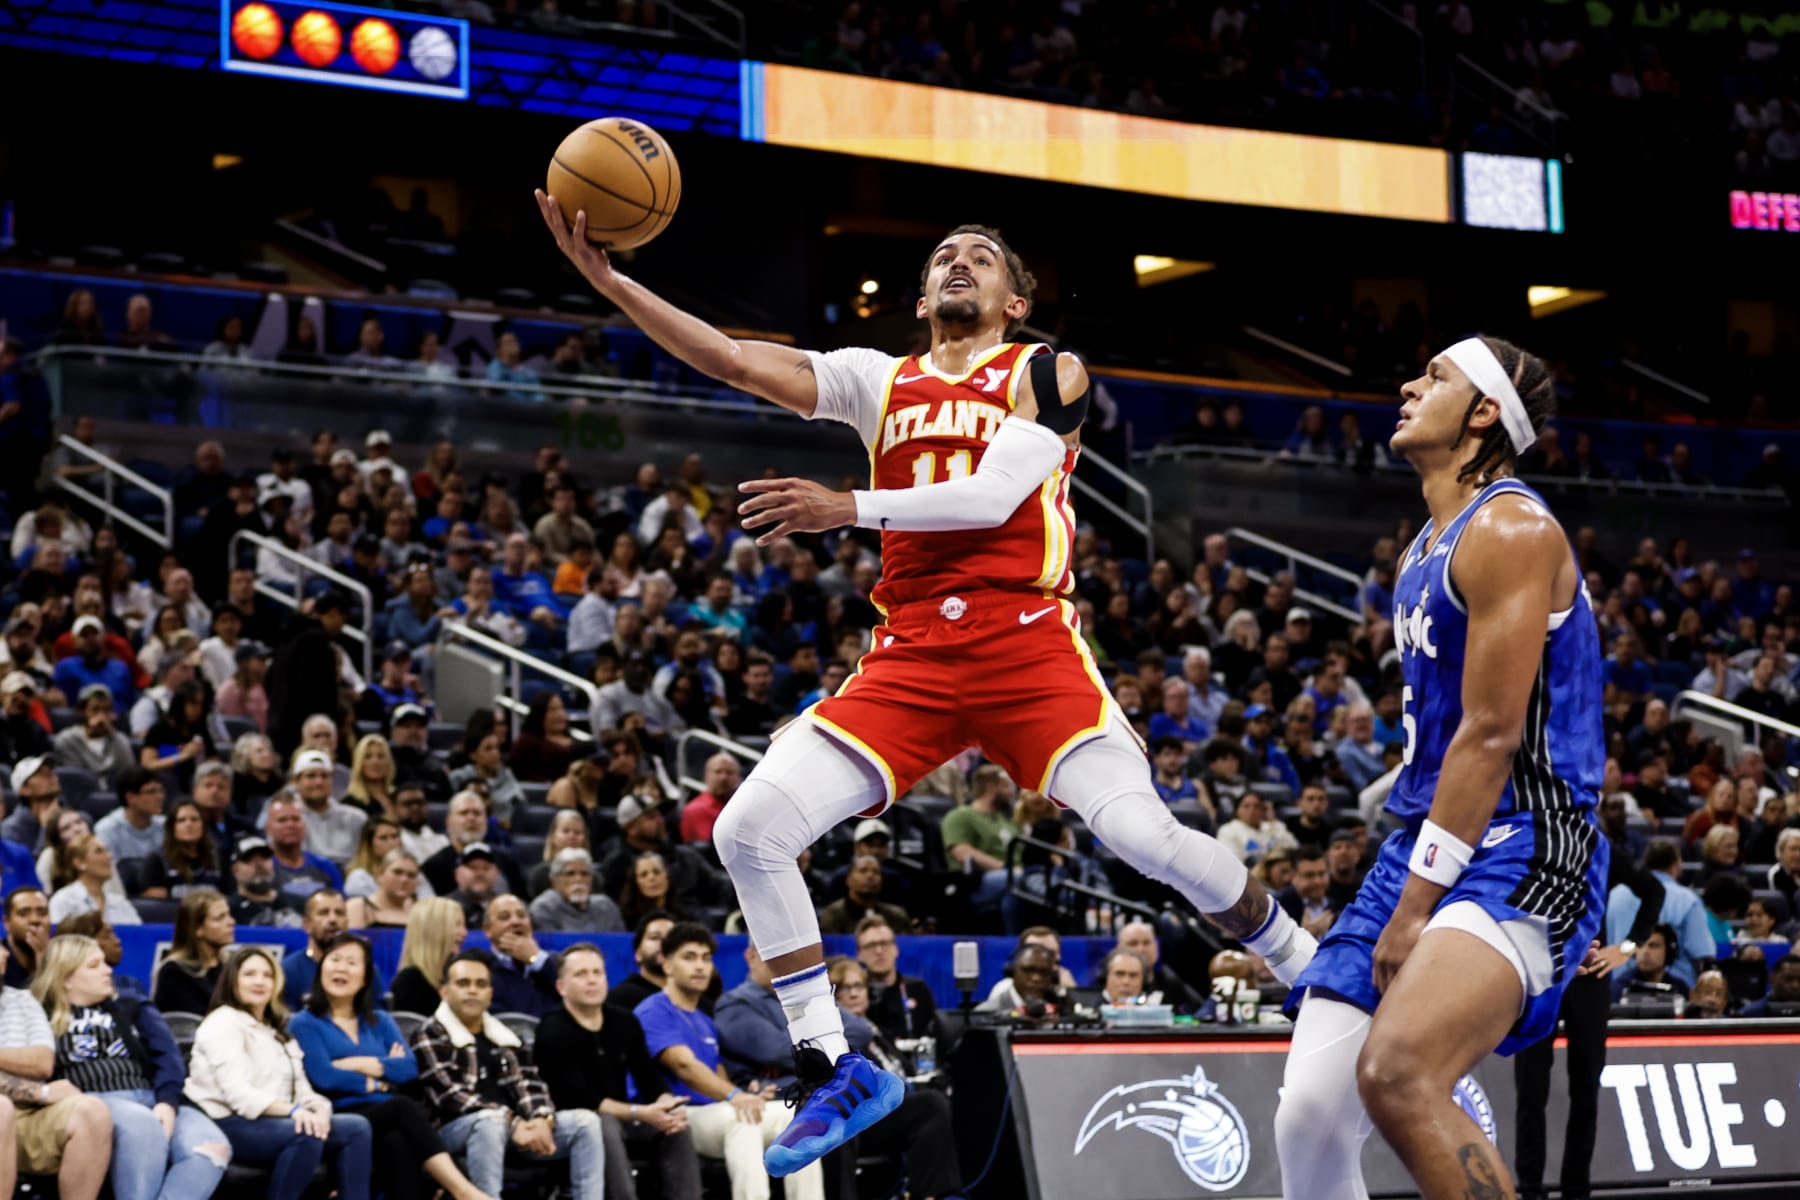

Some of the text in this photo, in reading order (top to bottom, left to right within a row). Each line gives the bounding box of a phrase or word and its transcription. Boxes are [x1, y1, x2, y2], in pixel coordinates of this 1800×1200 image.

[1730, 190, 1800, 231] DEFE
[881, 400, 1006, 456] ATLANT
[1402, 684, 1417, 766] 5
[1600, 1063, 1757, 1172] TUE
